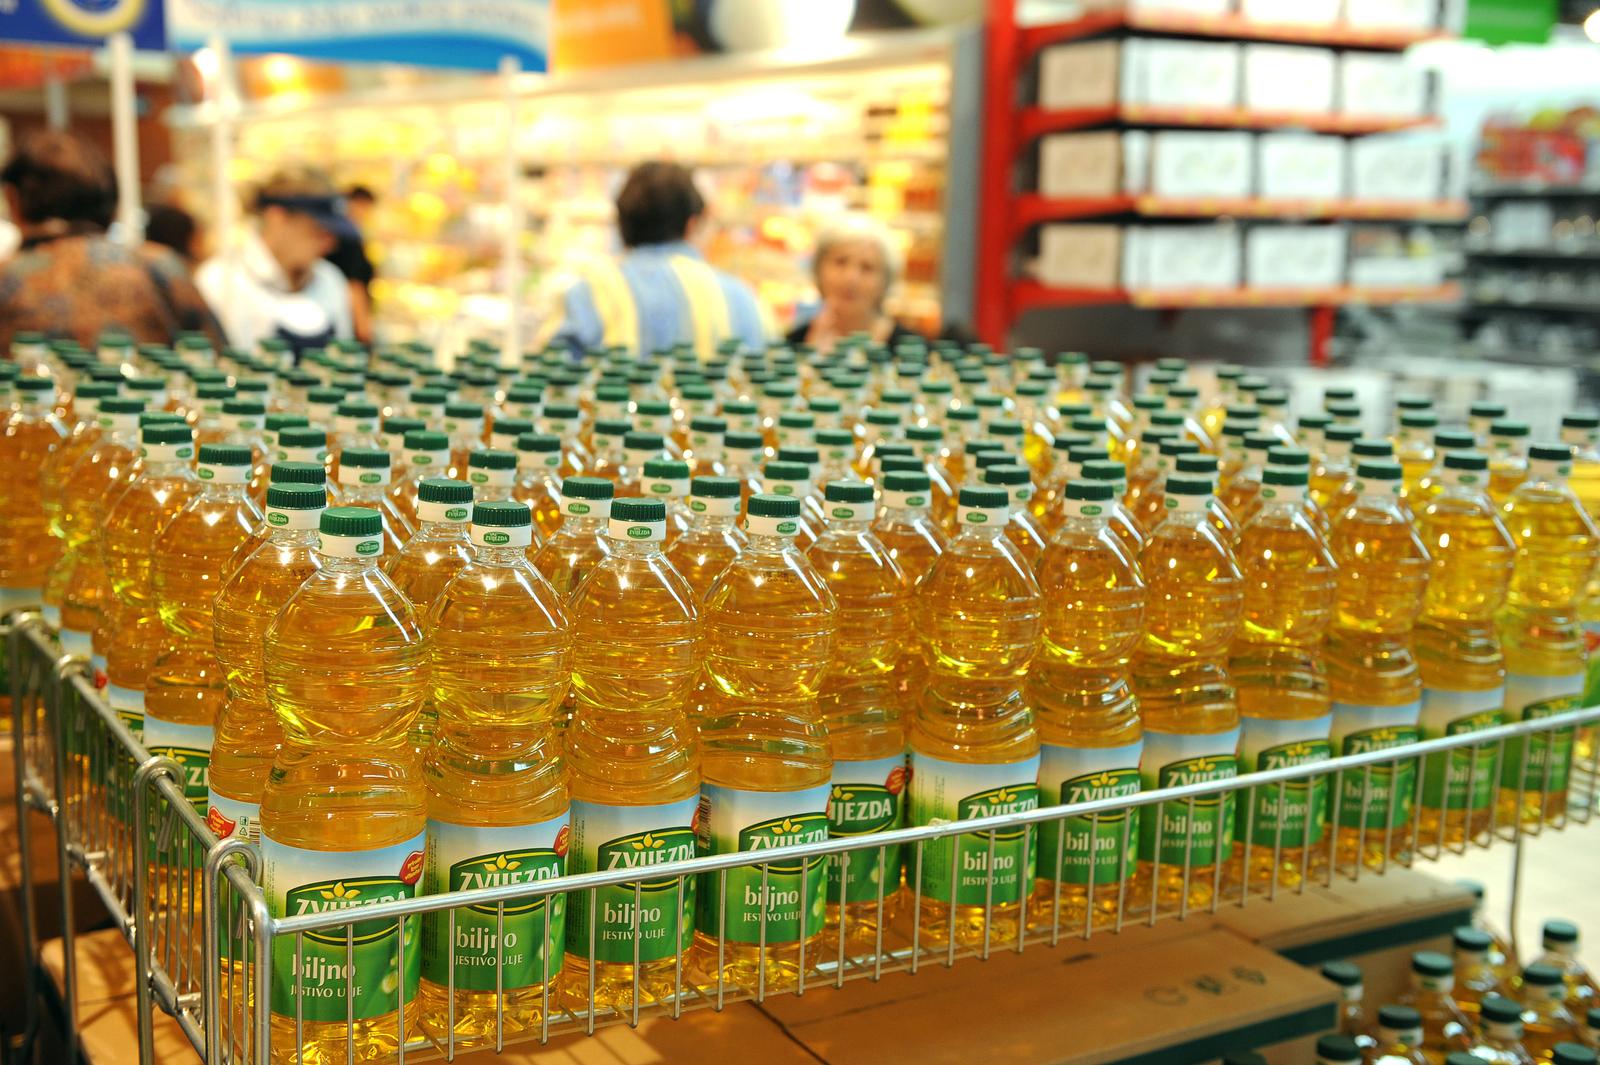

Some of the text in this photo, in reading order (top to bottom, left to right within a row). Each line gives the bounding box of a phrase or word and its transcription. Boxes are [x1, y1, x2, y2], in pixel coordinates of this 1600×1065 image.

[1165, 815, 1212, 834] bilno
[1066, 832, 1115, 851] bilno
[964, 851, 1014, 870] bilno
[745, 885, 799, 912] biljno
[604, 902, 661, 930] biljno
[743, 912, 781, 922] JESTVO
[645, 928, 666, 939] ULJE
[455, 955, 496, 966] JESTIVO
[292, 954, 356, 987] biljno
[337, 986, 362, 998] UJE
